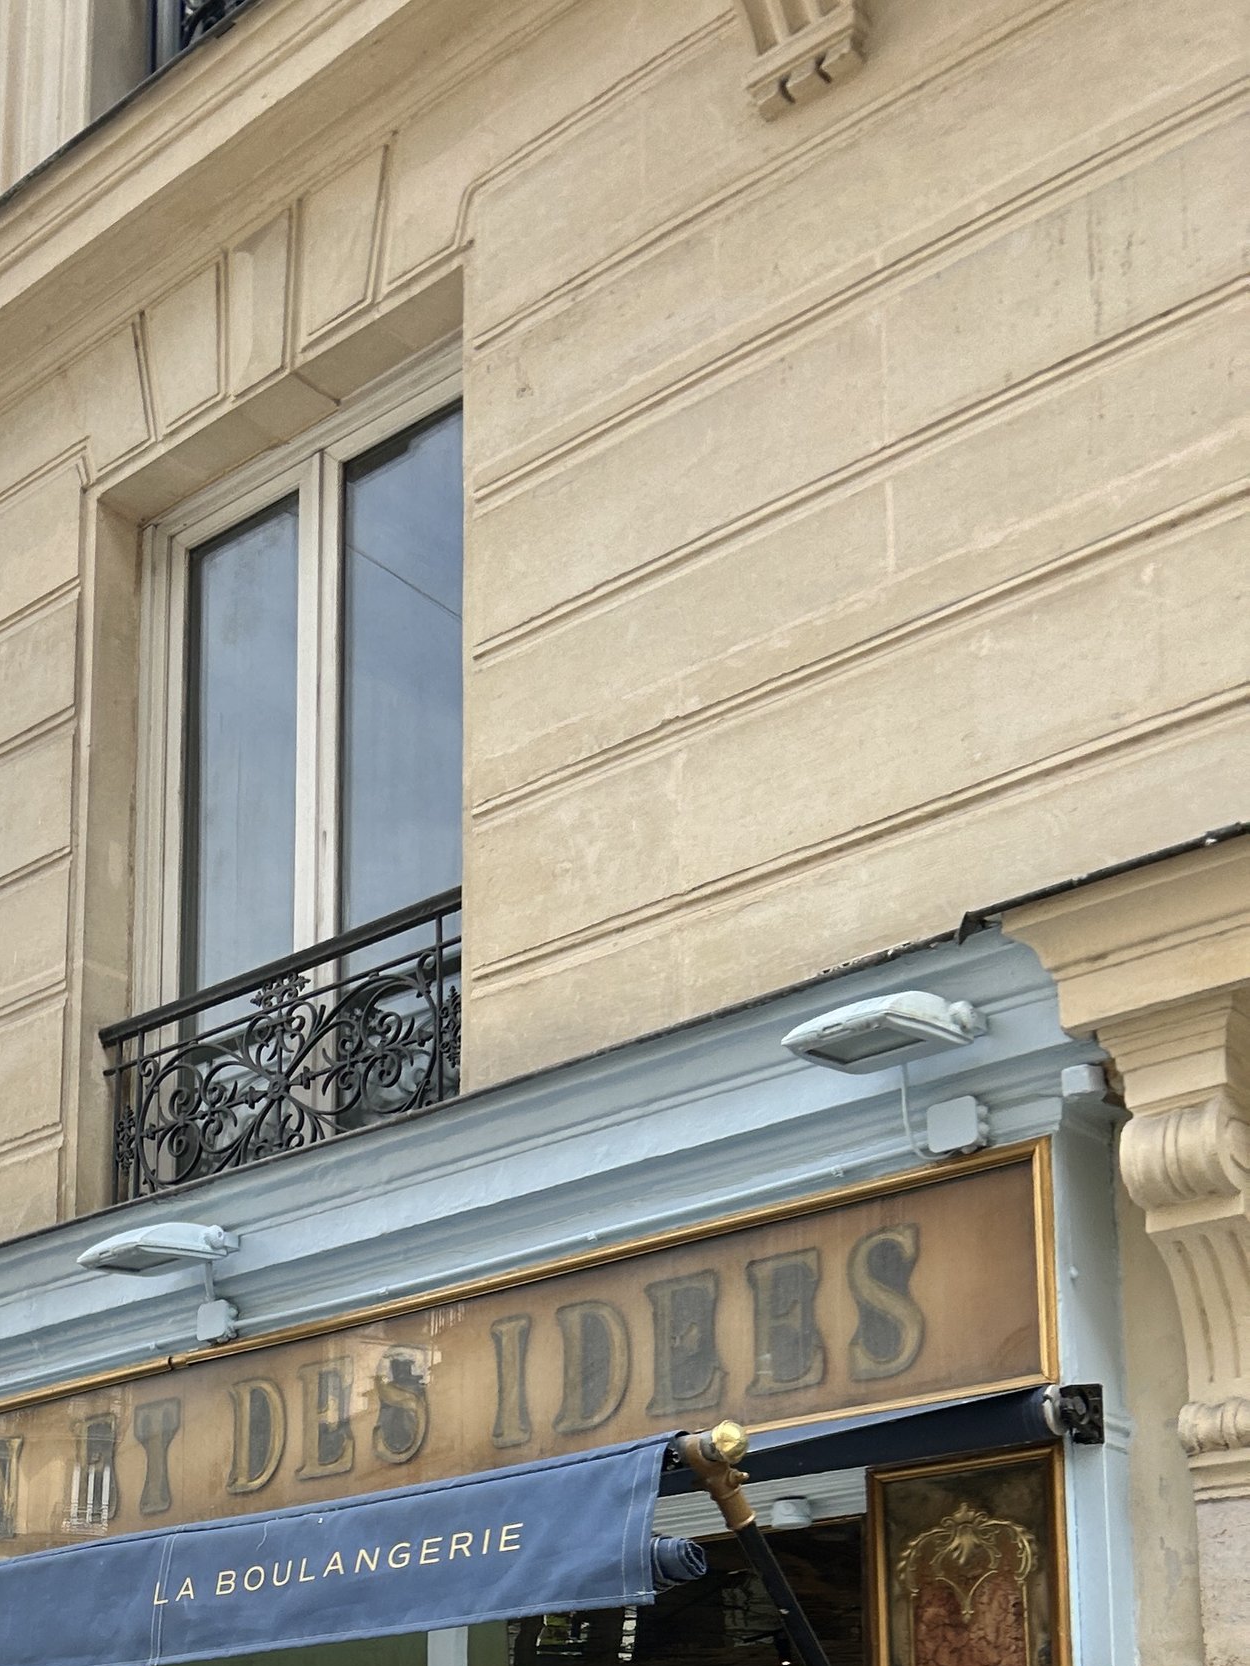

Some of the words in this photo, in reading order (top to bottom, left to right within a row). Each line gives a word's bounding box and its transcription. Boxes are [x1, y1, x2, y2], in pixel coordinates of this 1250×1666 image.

[226, 1345, 431, 1494] DES
[152, 1576, 196, 1606] LA
[215, 1522, 525, 1597] BOULANGERIE
